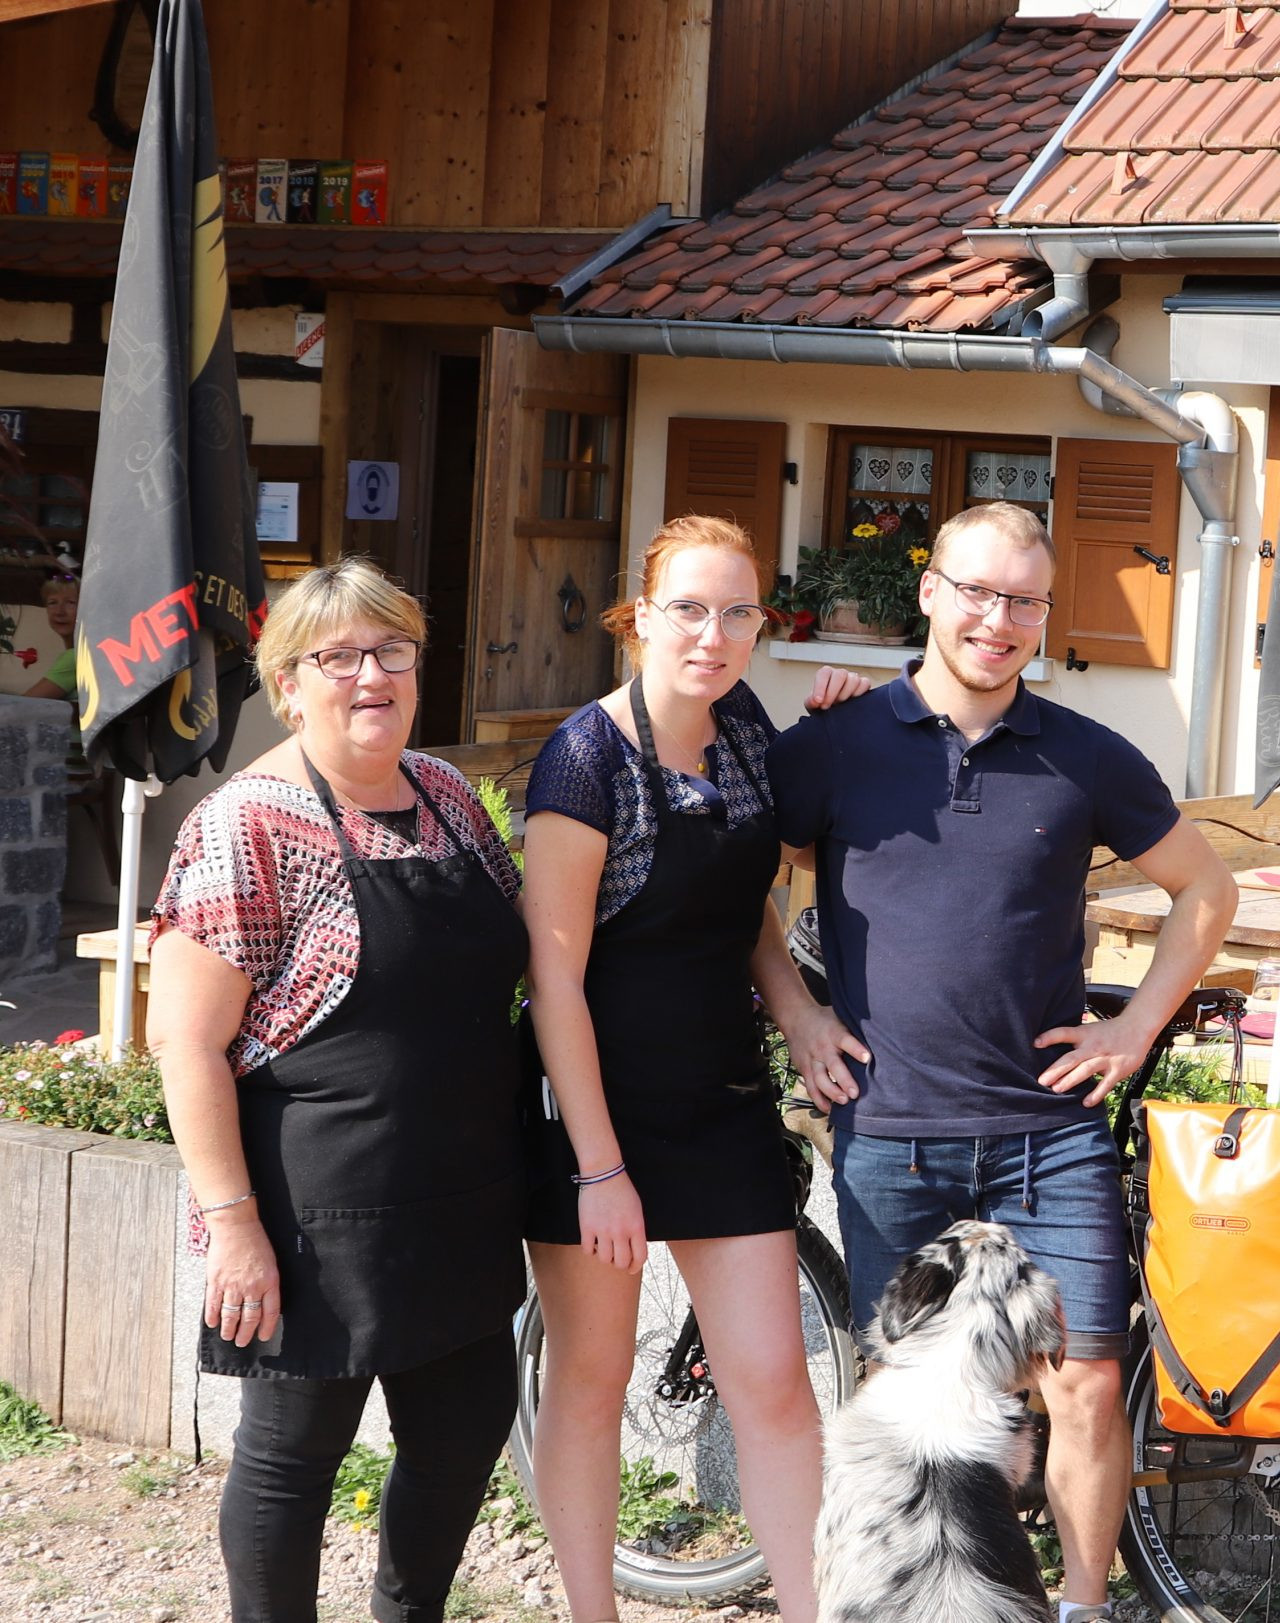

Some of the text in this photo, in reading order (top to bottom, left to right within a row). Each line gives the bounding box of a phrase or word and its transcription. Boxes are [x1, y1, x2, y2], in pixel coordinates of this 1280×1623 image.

[258, 176, 283, 185] 2017
[322, 176, 348, 186] 2019
[203, 575, 226, 606] ET
[96, 580, 199, 687] MET
[1192, 1217, 1223, 1227] ORTLIEB
